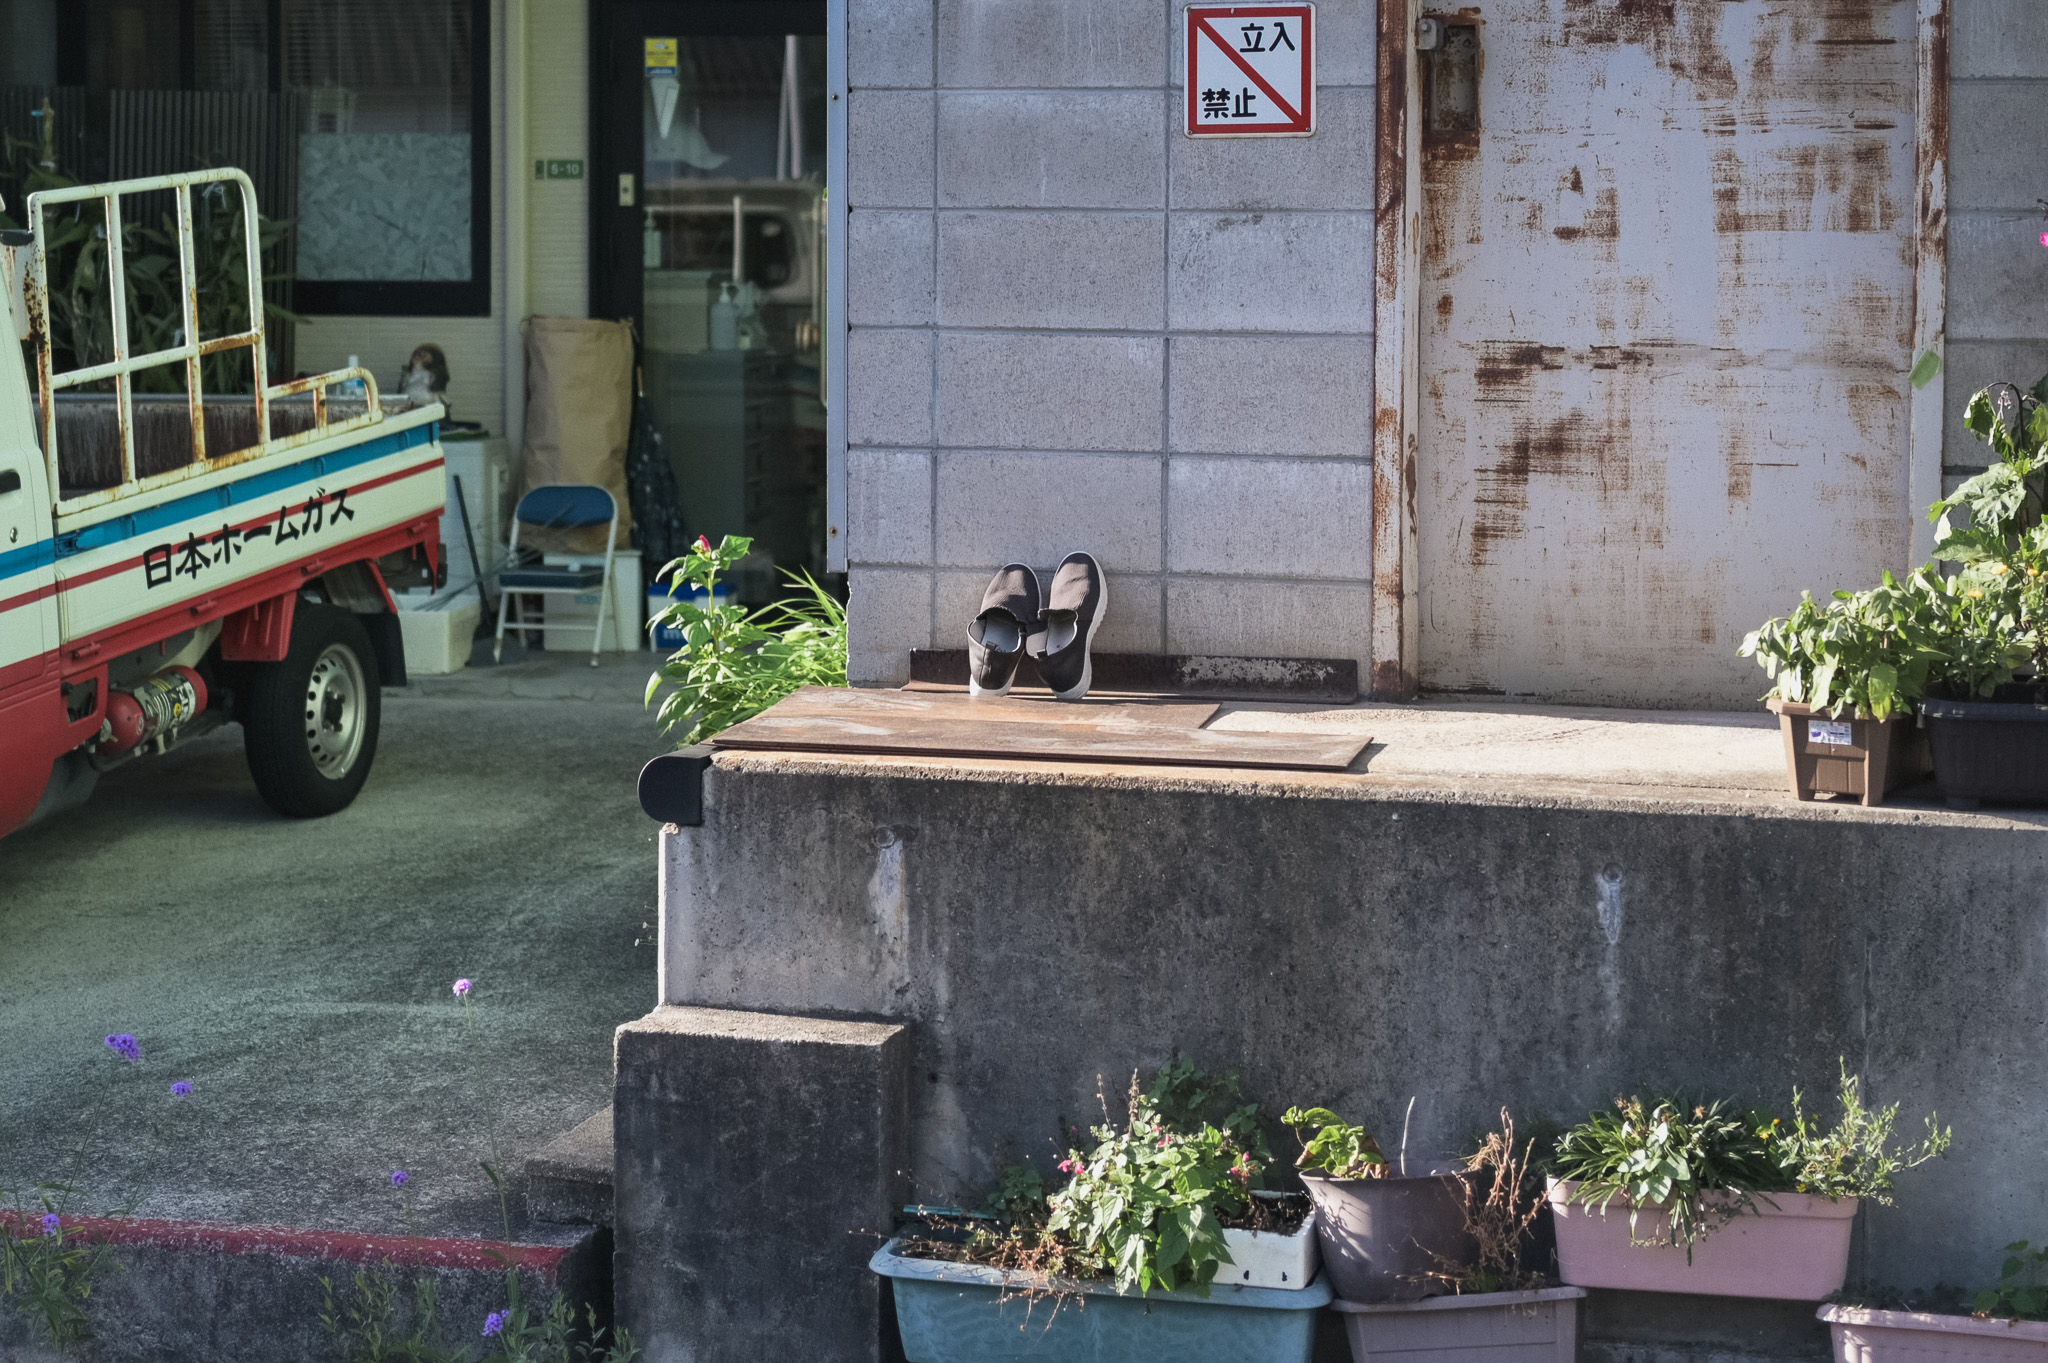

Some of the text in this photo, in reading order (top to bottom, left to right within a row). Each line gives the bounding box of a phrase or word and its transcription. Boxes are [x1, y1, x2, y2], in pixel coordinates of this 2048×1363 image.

[1239, 21, 1296, 53] 立入
[1201, 87, 1258, 119] 禁止
[143, 486, 355, 590] 日本ホームガス
